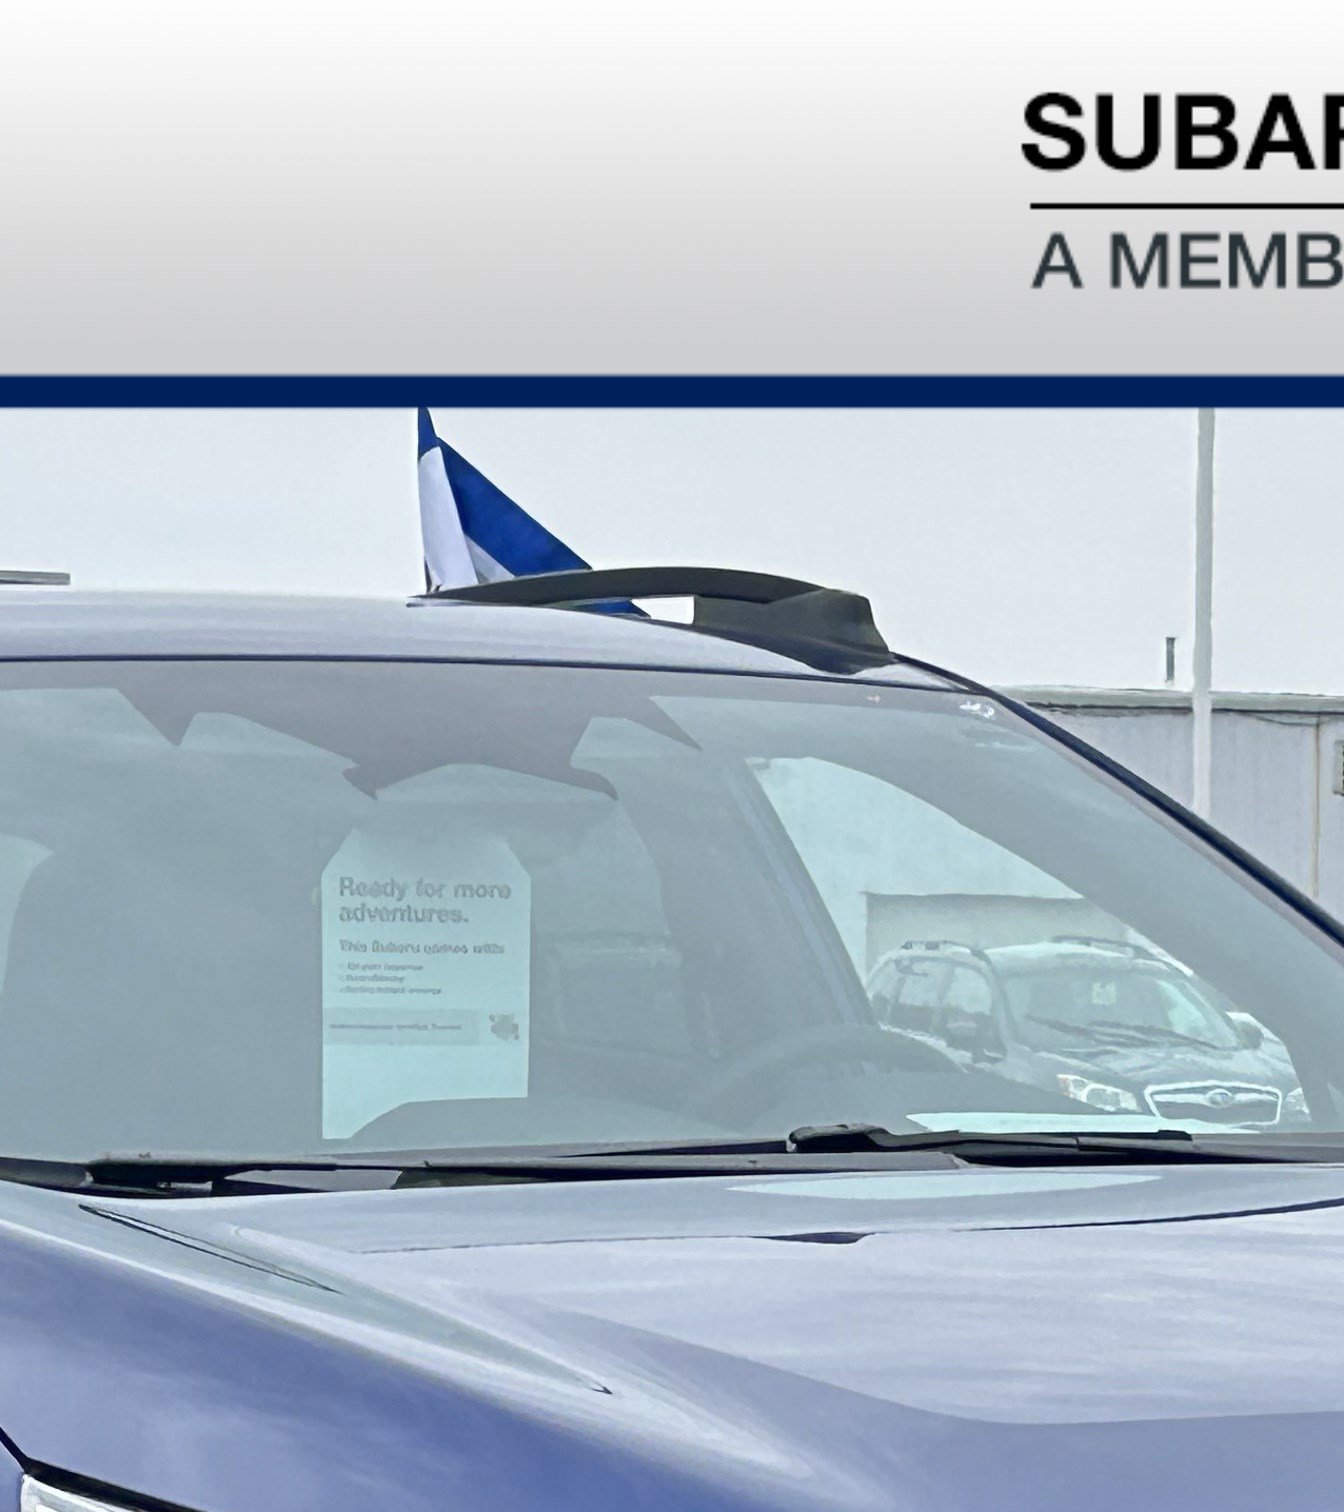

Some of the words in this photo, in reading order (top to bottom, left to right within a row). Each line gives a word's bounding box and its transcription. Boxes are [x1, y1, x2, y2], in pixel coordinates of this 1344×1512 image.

[339, 876, 407, 900] Ready
[416, 877, 446, 899] for
[454, 883, 511, 899] more
[339, 903, 469, 923] adventures.
